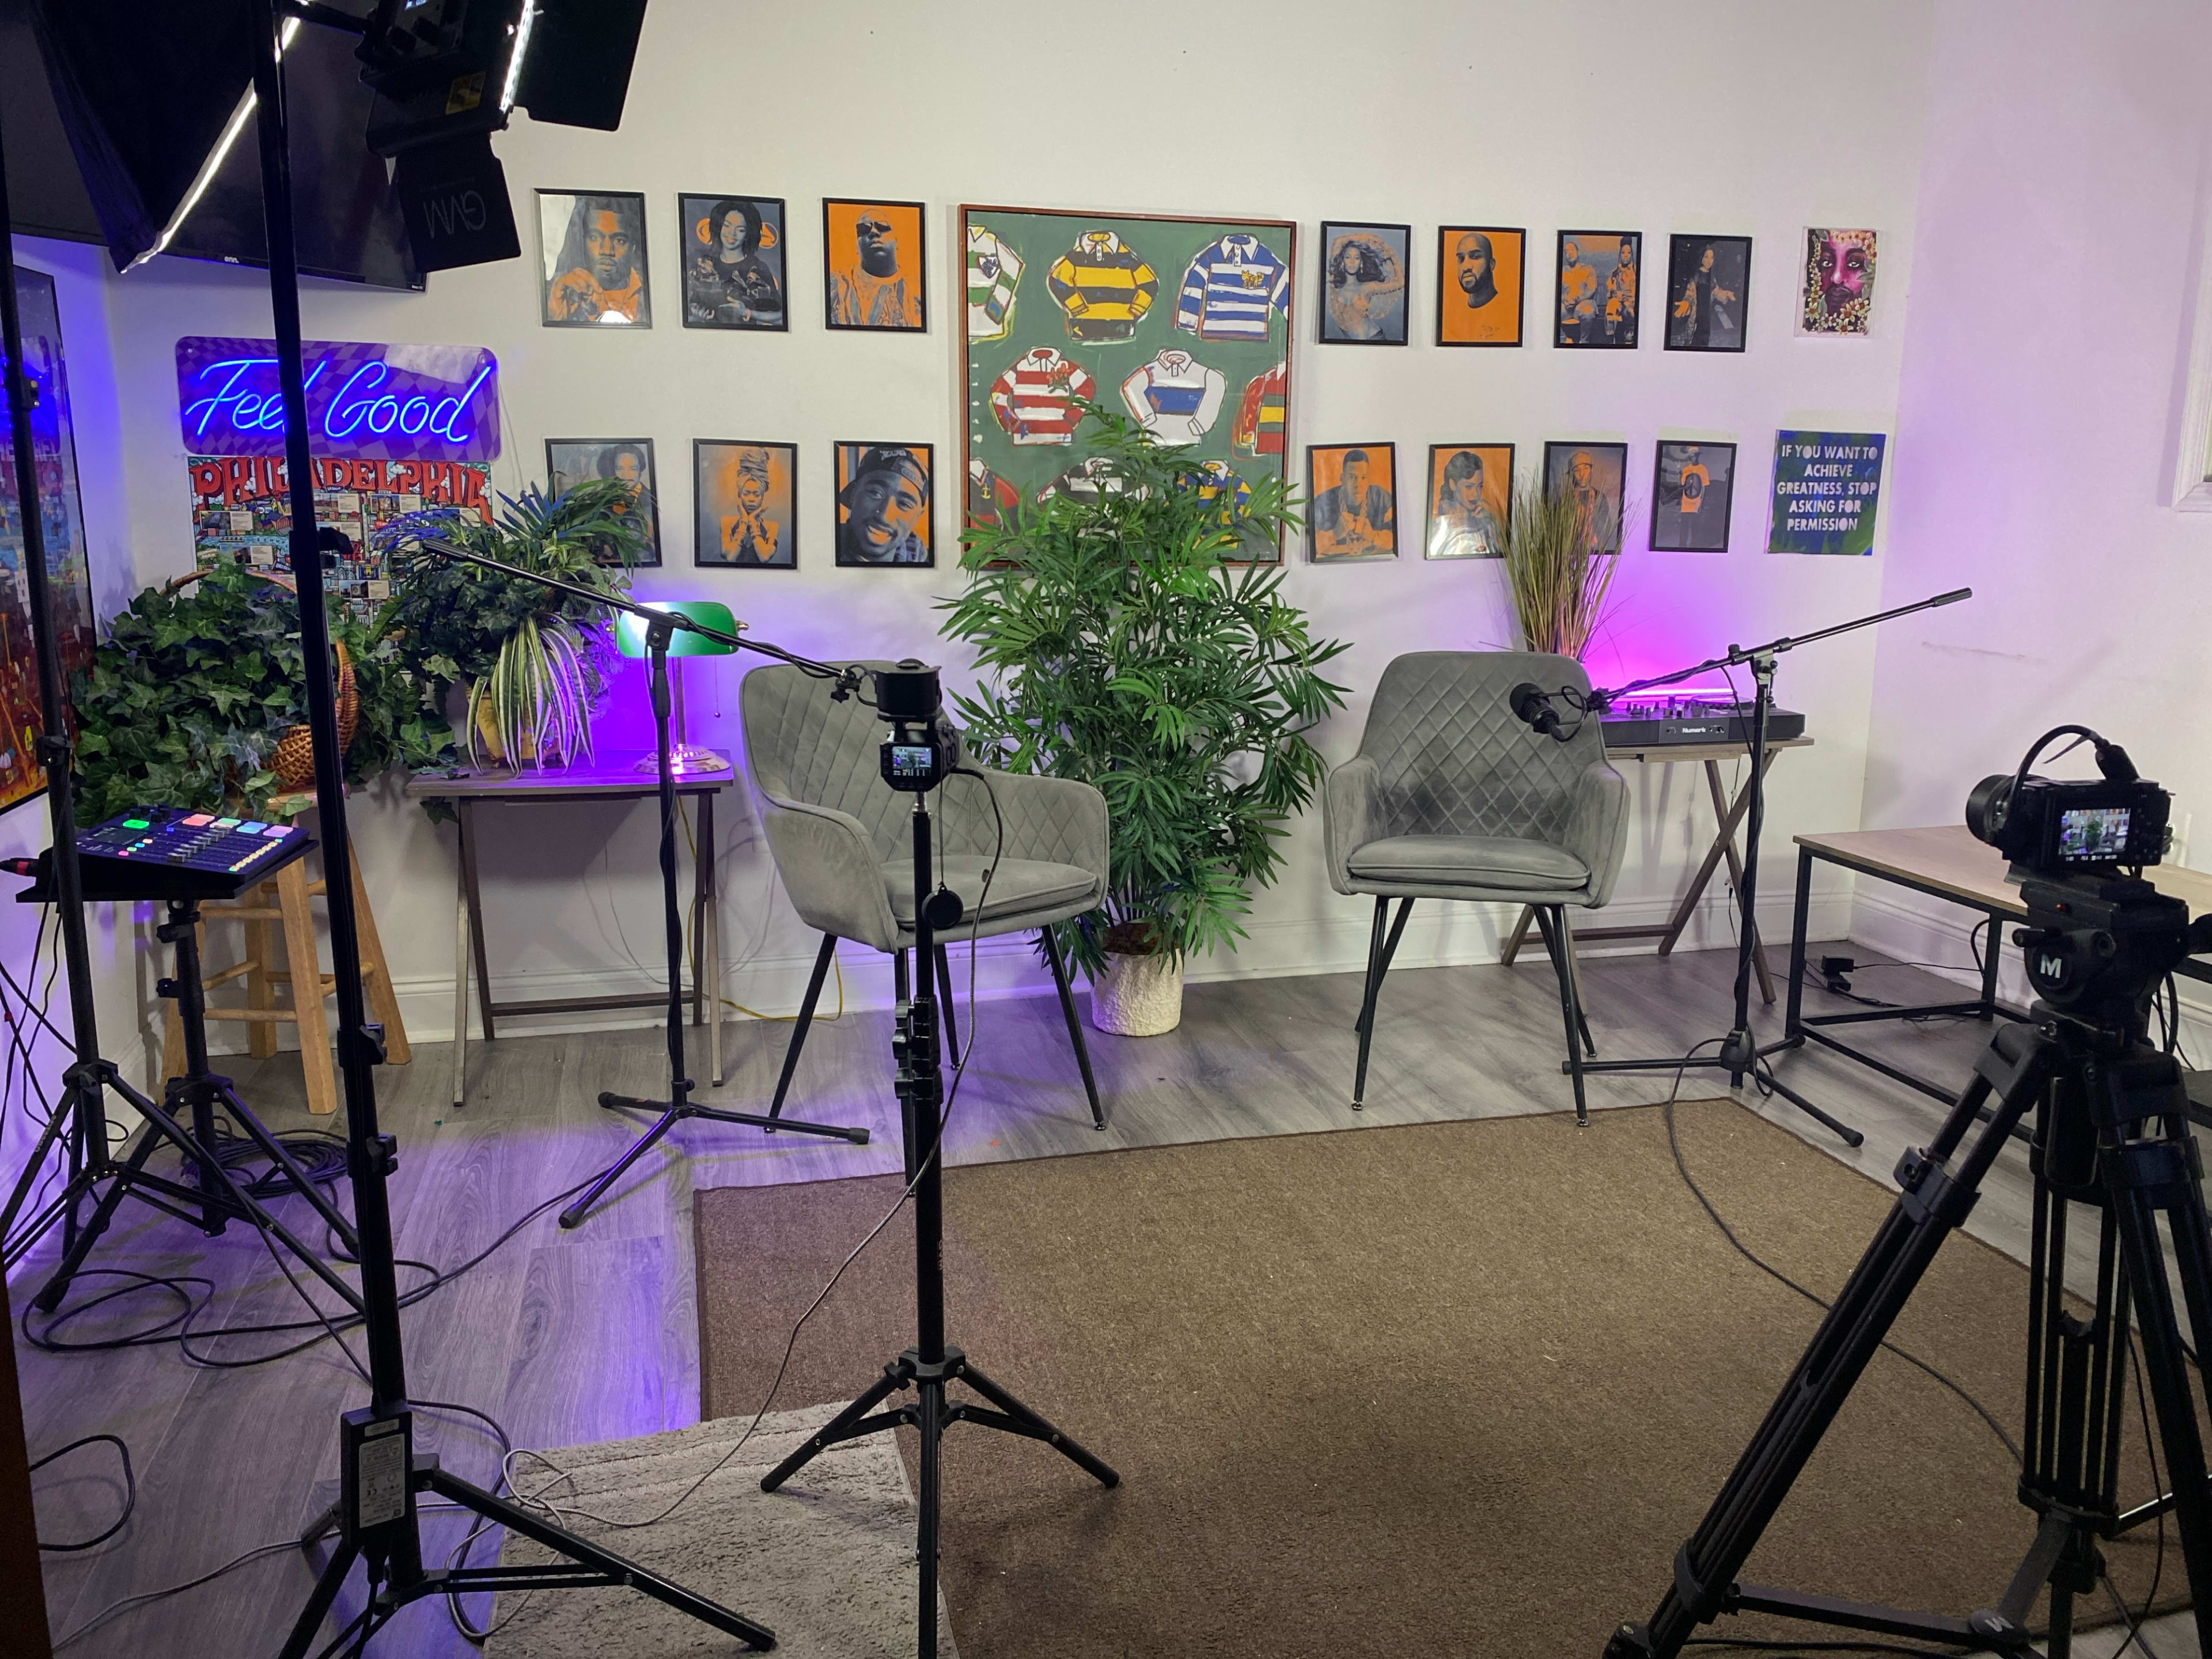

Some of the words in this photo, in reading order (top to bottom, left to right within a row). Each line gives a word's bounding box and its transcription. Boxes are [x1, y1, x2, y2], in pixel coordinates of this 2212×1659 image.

[324, 361, 491, 442] Good
[1782, 445, 1792, 457] IF
[1796, 445, 1821, 459] YOU
[1824, 445, 1861, 460] WANT
[1863, 446, 1878, 460] TO
[1804, 464, 1853, 477] ACHIEVE
[1777, 482, 1844, 496] GREATNESS,
[1847, 482, 1877, 495] STOP
[1789, 499, 1836, 513] ASKING
[1838, 500, 1861, 513] FOR
[1787, 517, 1858, 532] PERMISSION
[2040, 953, 2062, 979] M
